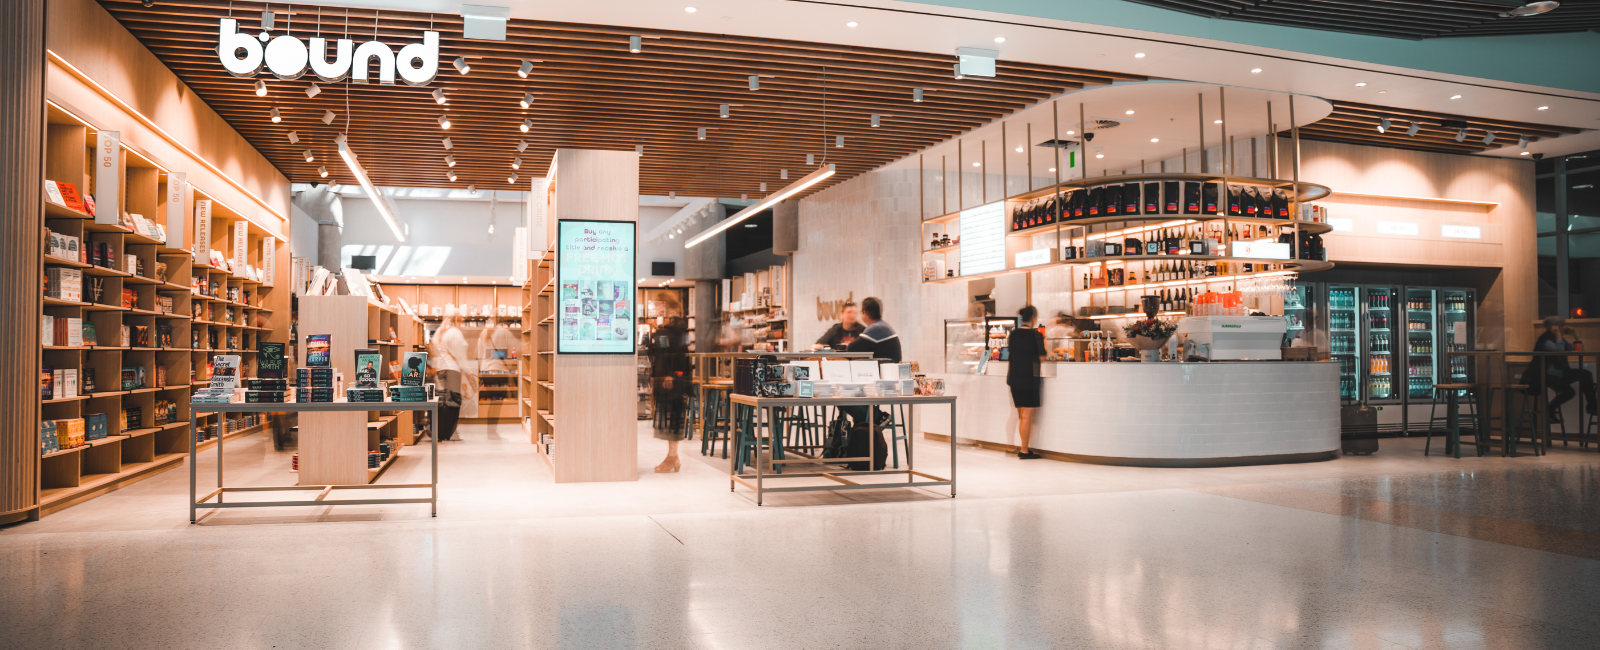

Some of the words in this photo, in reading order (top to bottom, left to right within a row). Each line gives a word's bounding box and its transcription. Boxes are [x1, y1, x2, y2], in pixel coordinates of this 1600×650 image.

[219, 18, 440, 86] bound
[104, 134, 112, 154] TOP
[104, 156, 112, 168] 50
[172, 194, 180, 202] 50
[566, 252, 597, 262] FREE
[601, 253, 628, 263] HOT
